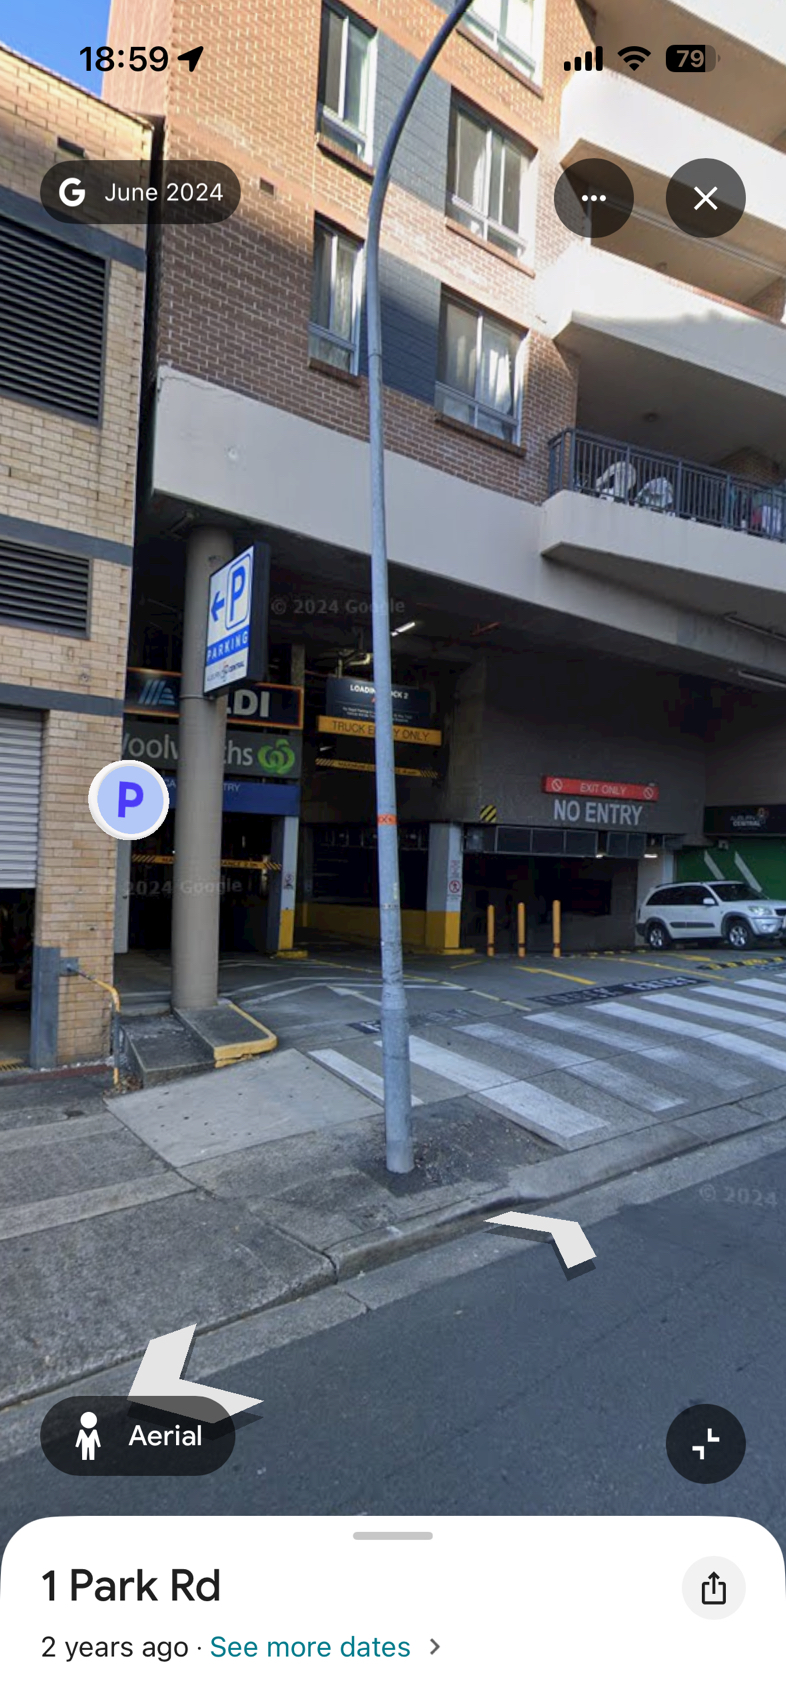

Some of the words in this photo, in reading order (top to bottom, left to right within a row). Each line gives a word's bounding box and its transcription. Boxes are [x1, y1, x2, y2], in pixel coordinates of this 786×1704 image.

[230, 565, 246, 622] P
[207, 630, 249, 663] PARKING
[332, 720, 365, 734] TRUCK
[402, 729, 430, 742] ONLY
[580, 782, 600, 793] EXIT
[601, 785, 628, 795] ONLY
[553, 798, 581, 822] NO
[585, 801, 643, 826] ENTRY
